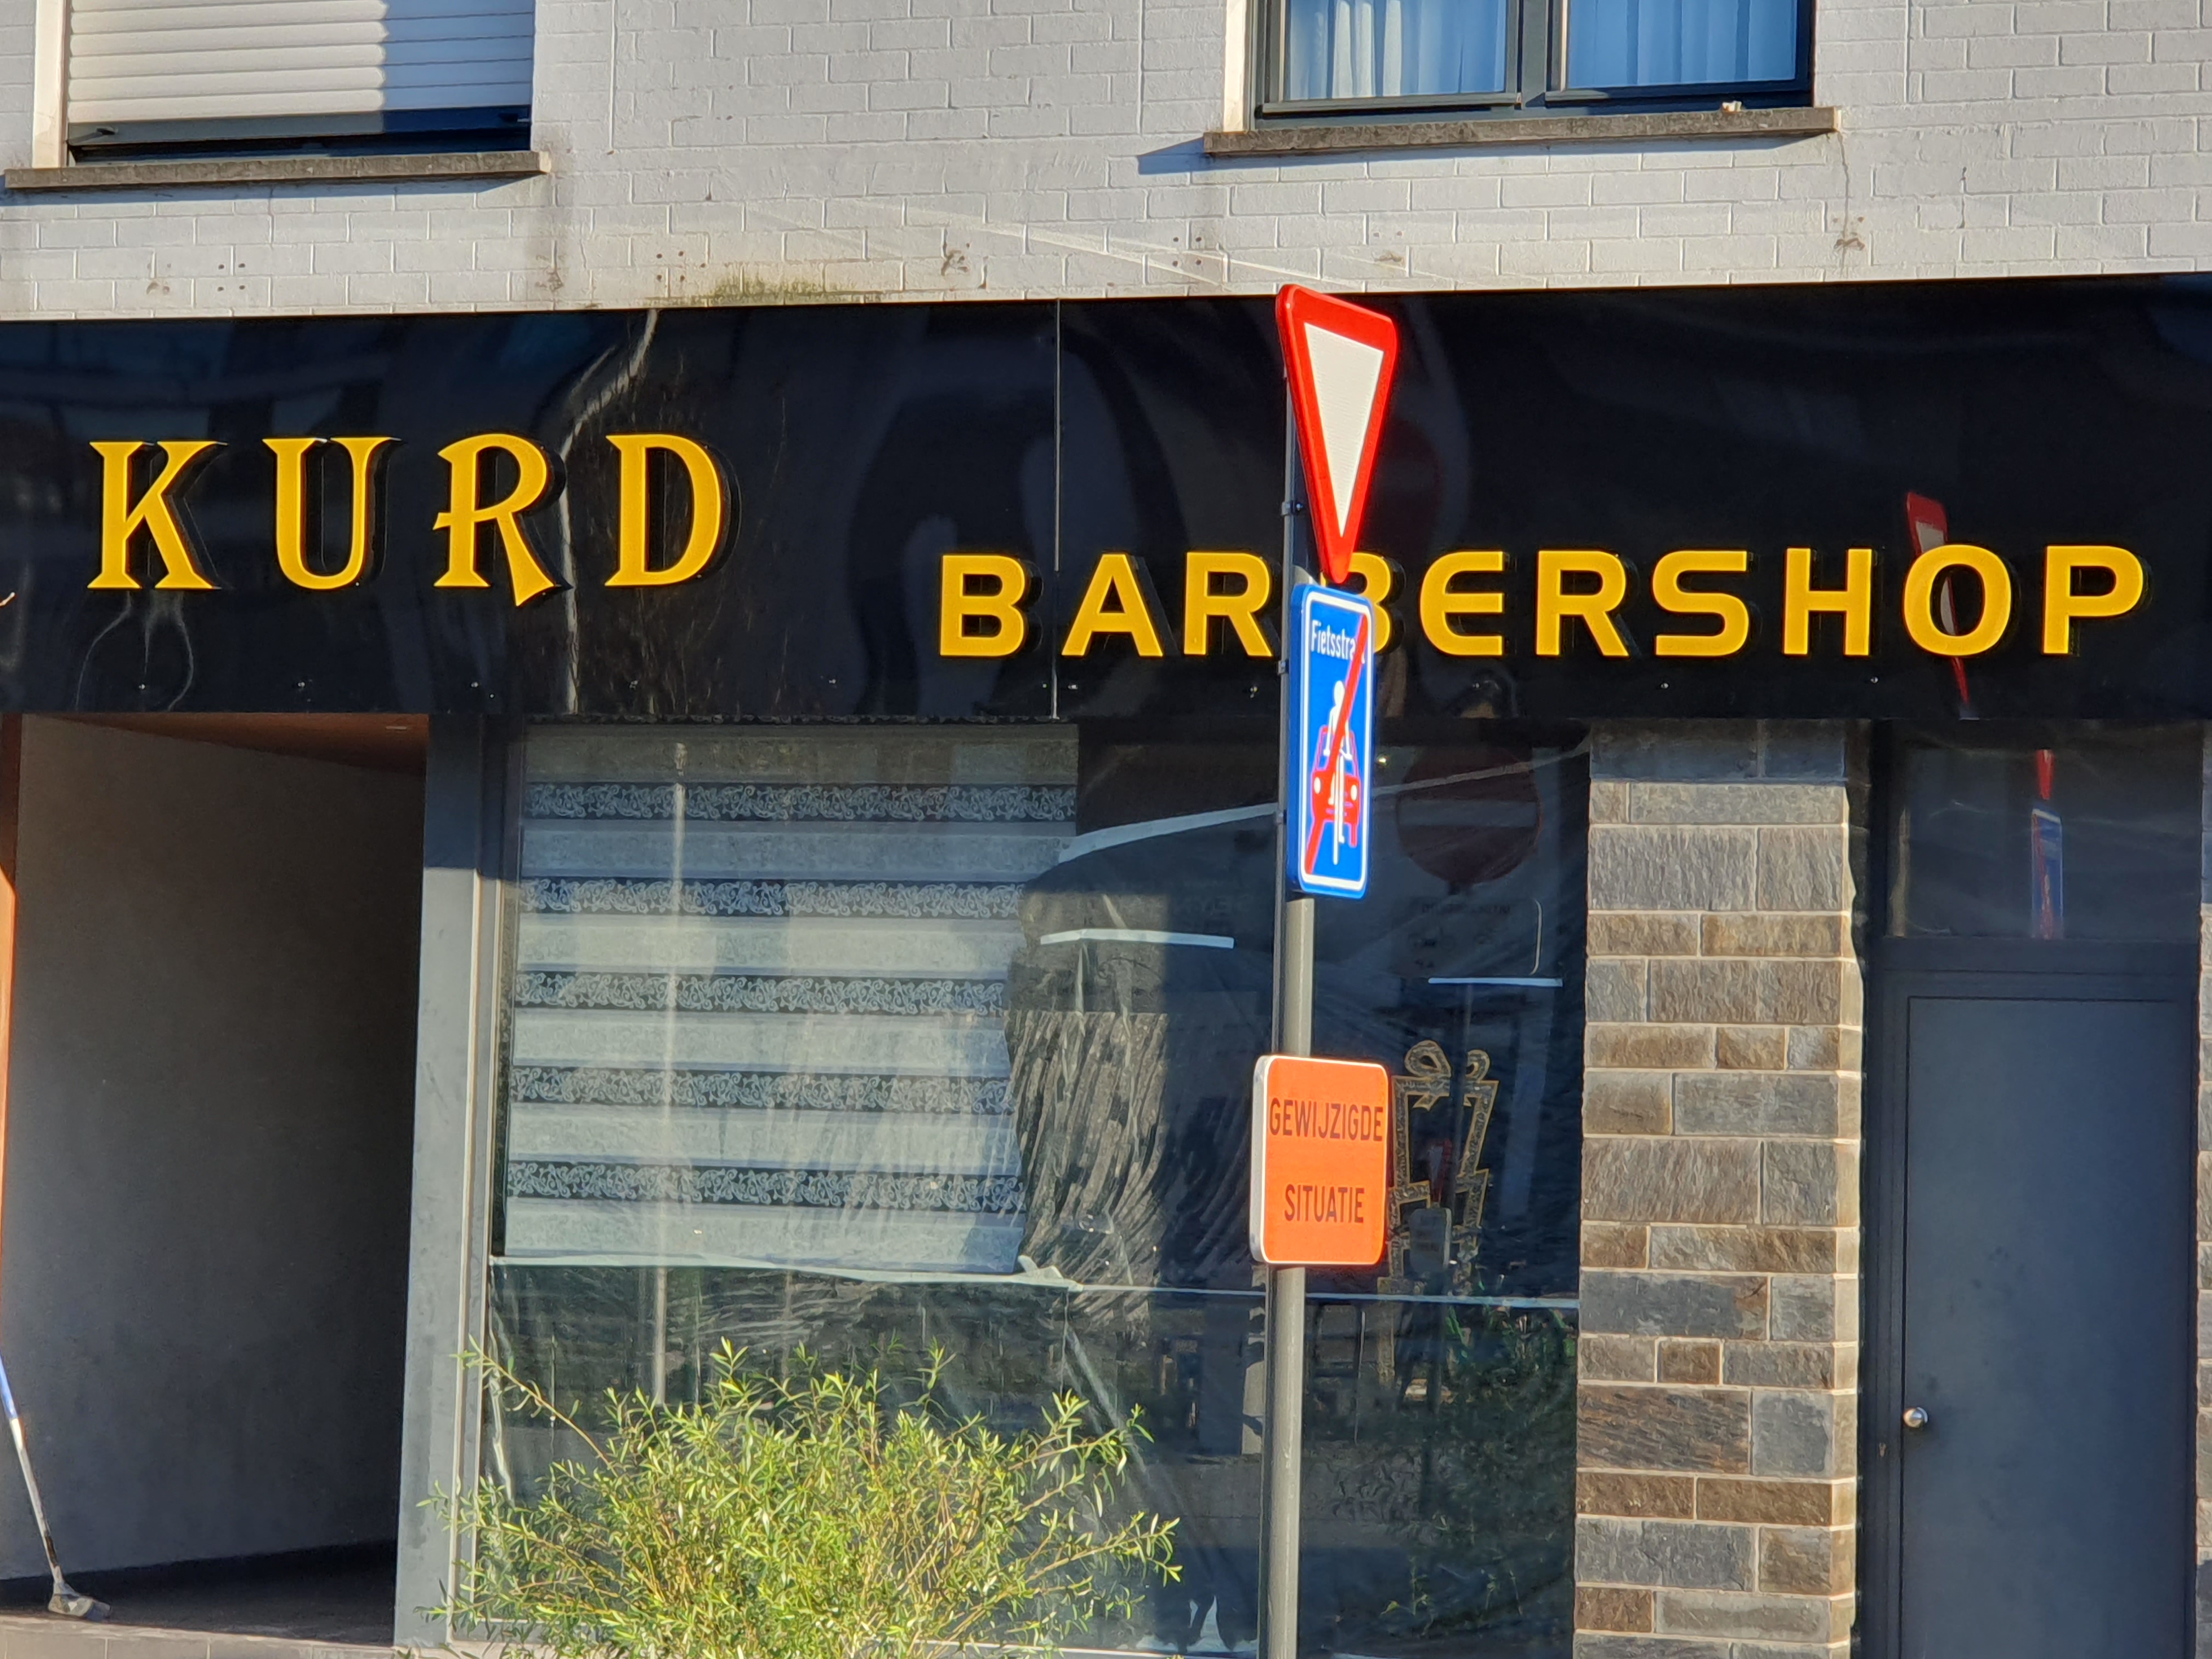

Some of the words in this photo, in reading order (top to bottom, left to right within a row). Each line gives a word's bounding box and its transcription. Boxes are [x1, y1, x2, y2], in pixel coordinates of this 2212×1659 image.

[88, 433, 722, 607] KURD
[1311, 619, 1365, 664] Fietsstra
[1269, 1097, 1384, 1142] GEWIJZIGDE
[1284, 1183, 1365, 1224] SITUATIE
